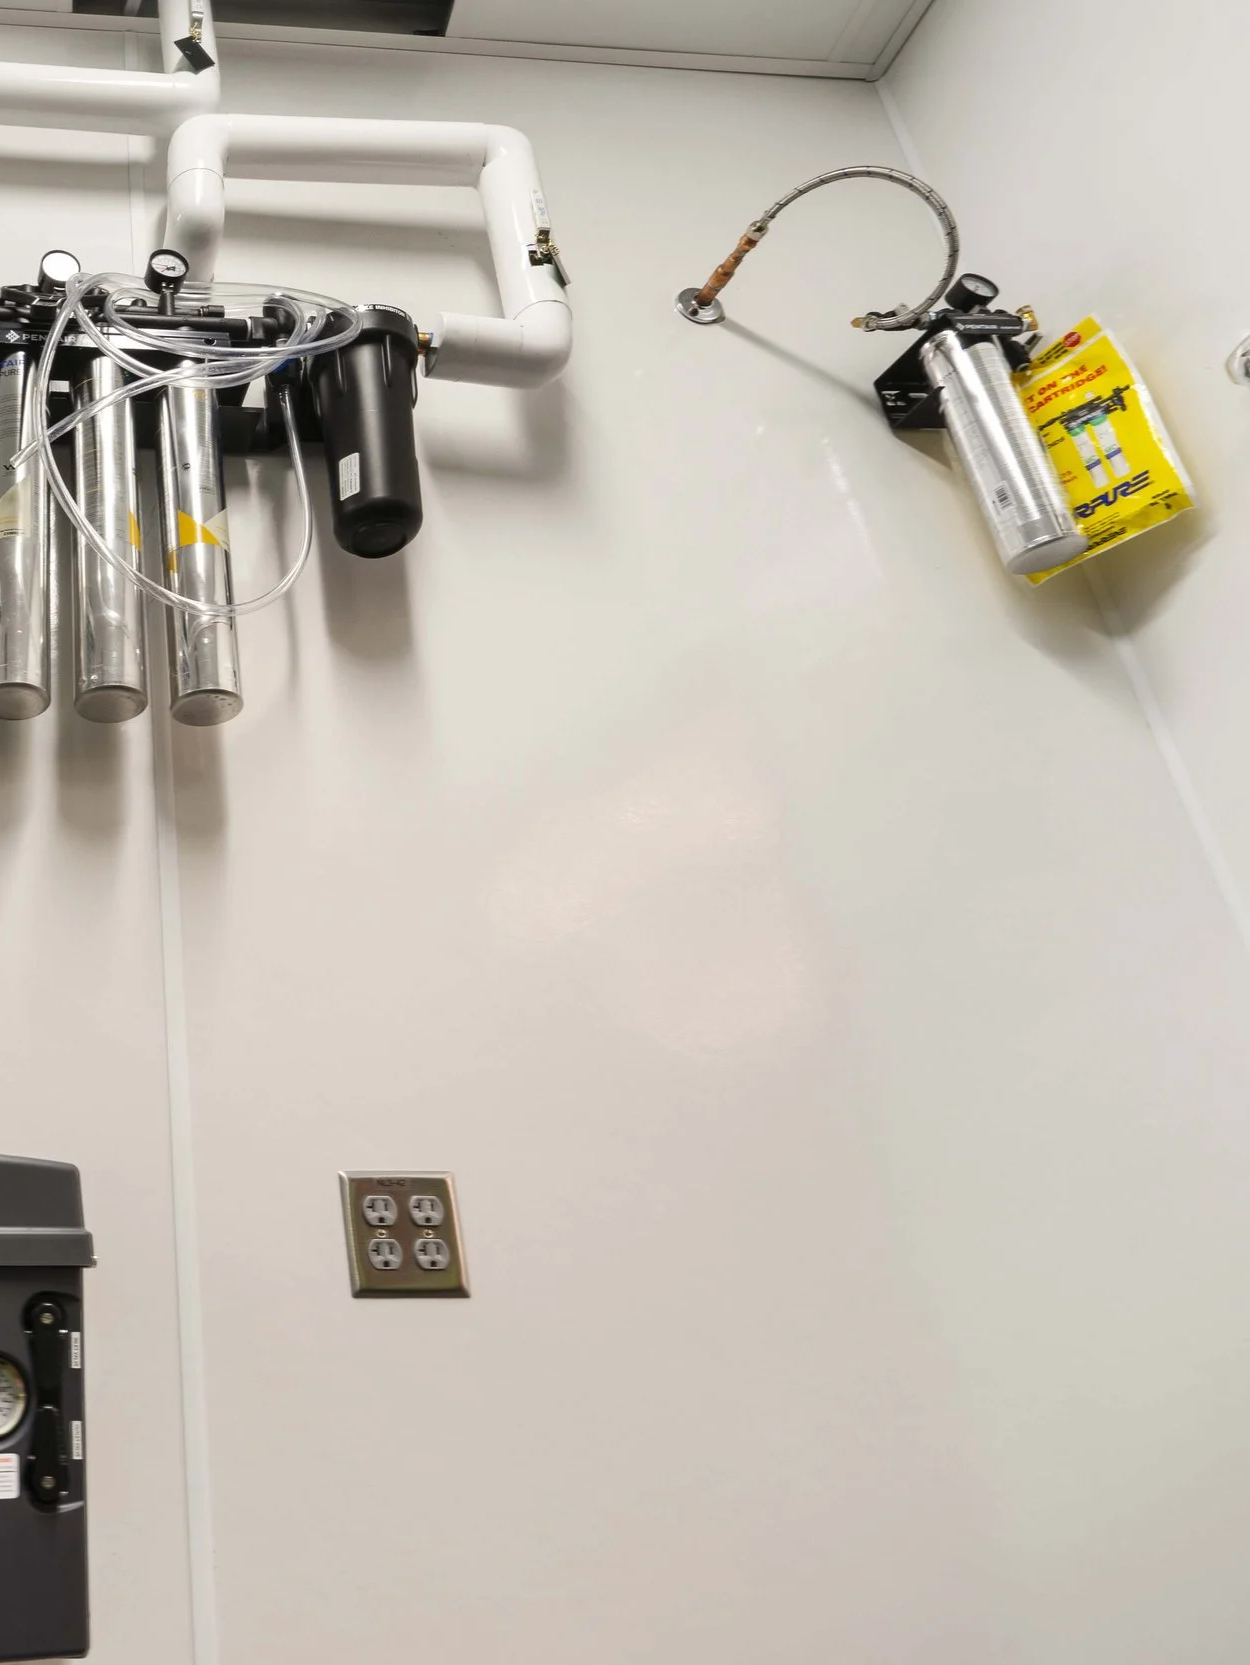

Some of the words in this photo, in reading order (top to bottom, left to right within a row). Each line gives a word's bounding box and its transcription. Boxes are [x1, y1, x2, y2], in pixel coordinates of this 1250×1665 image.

[22, 333, 77, 343] PENAIR
[1029, 364, 1107, 413] CARTRIDGE!
[1038, 381, 1057, 396] ON
[1074, 469, 1155, 518] RPURE
